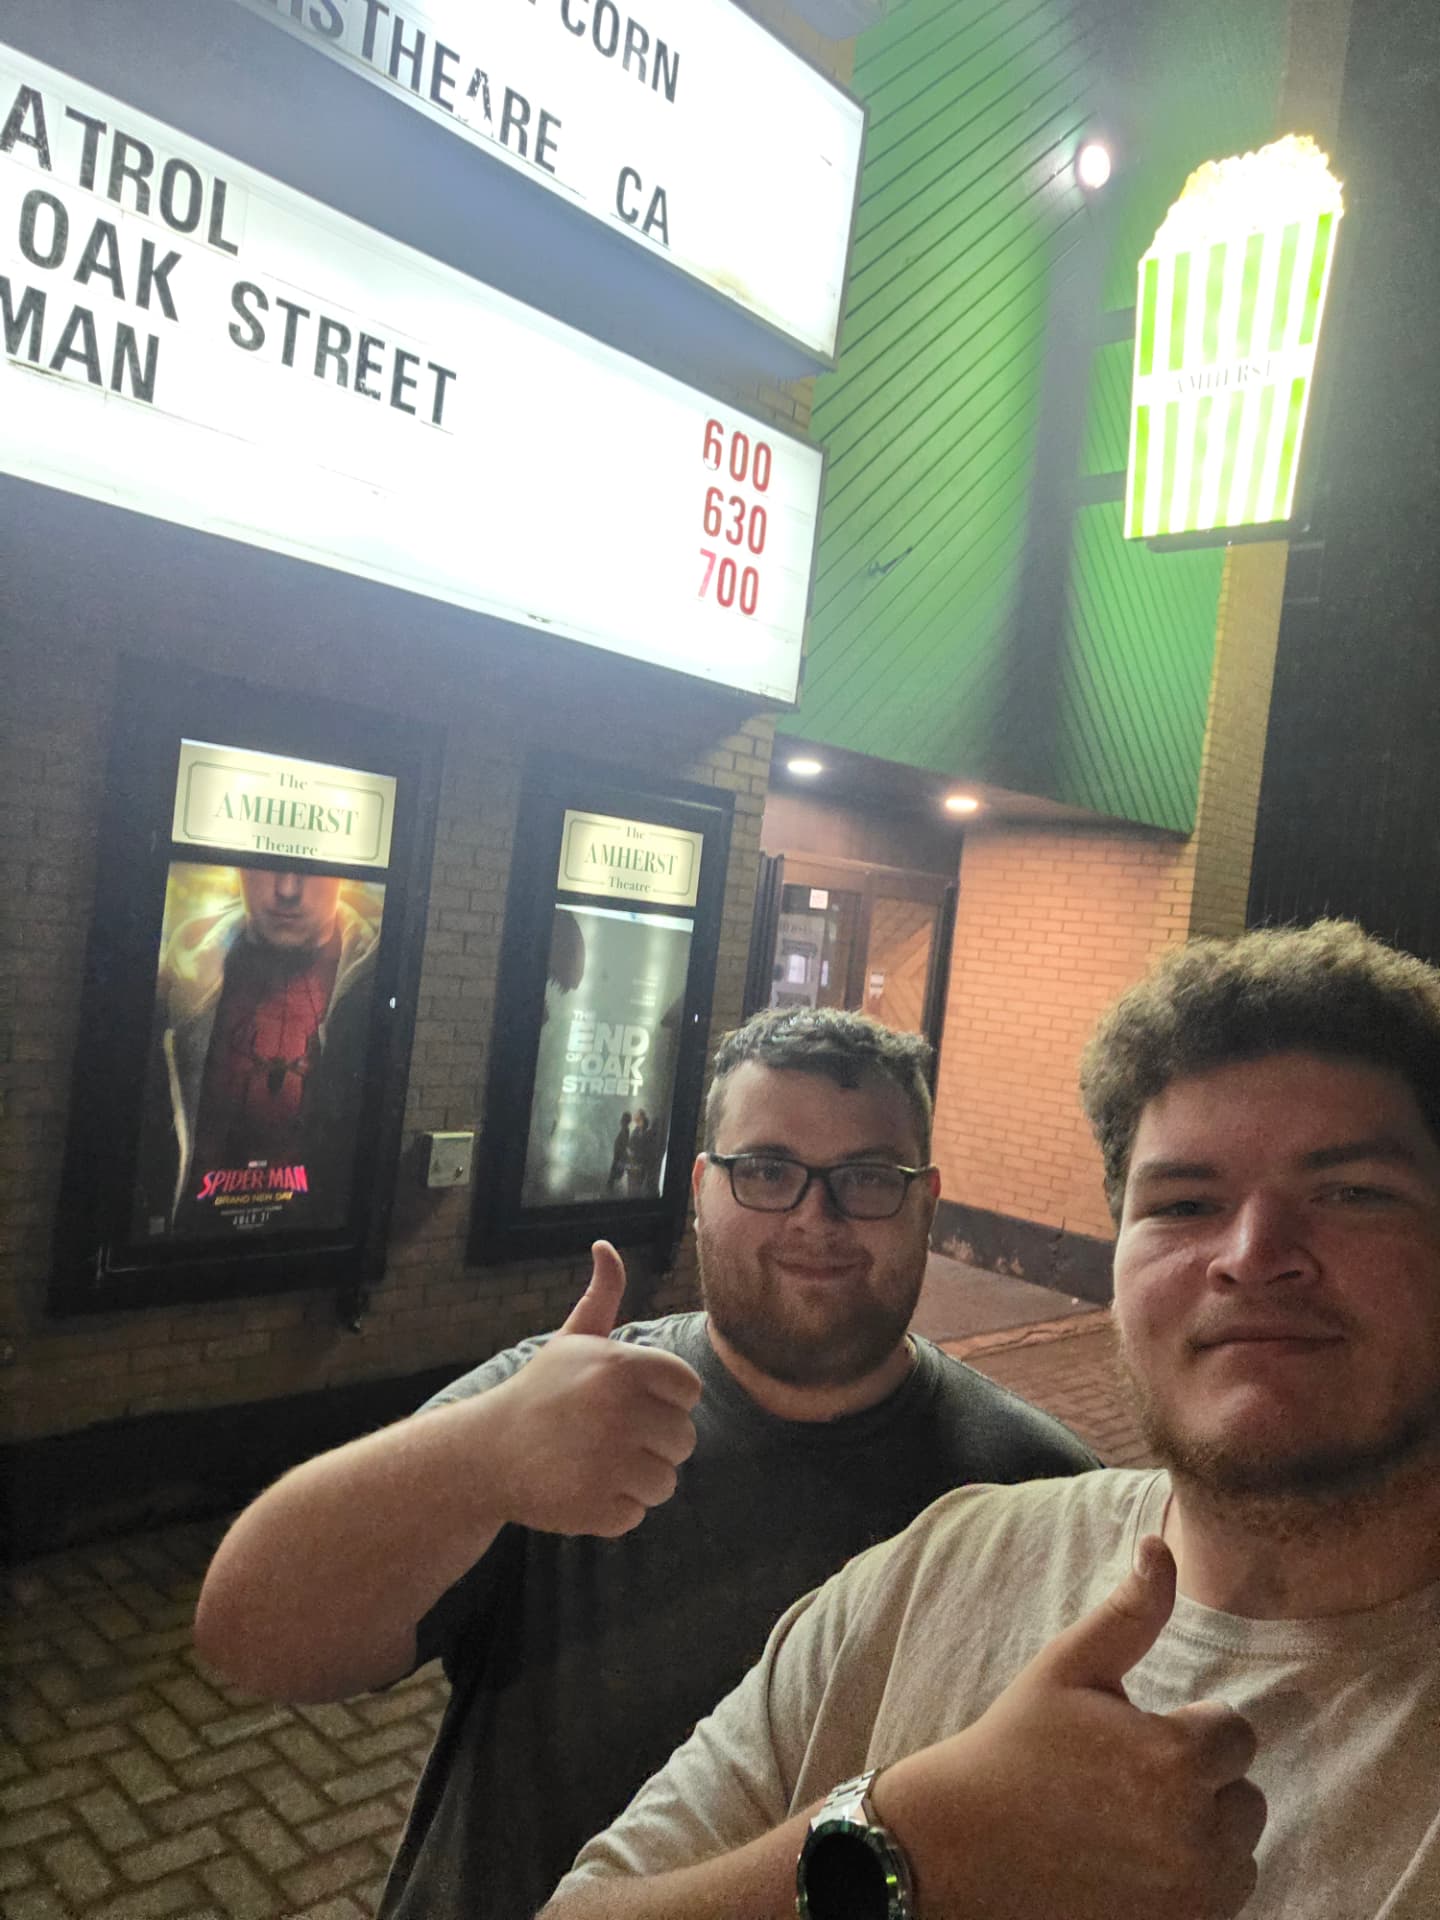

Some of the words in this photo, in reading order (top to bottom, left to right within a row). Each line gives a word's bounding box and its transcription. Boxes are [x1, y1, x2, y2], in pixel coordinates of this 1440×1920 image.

[527, 0, 680, 104] CORN
[0, 83, 240, 257] ATROL
[615, 166, 671, 247] CA
[18, 188, 183, 323] OAK
[227, 280, 457, 427] STREET
[0, 274, 161, 404] MAN
[702, 418, 773, 493] 600
[702, 486, 768, 555] 630
[697, 547, 760, 616] 700
[278, 772, 308, 791] The
[215, 791, 360, 836] AMHERST
[625, 825, 646, 840] The
[252, 833, 318, 857] Theatre
[584, 842, 679, 876] AMHERST
[608, 875, 651, 894] Theatre
[567, 1020, 651, 1057] END
[561, 1074, 644, 1098] STREET
[580, 1052, 646, 1081] OAK
